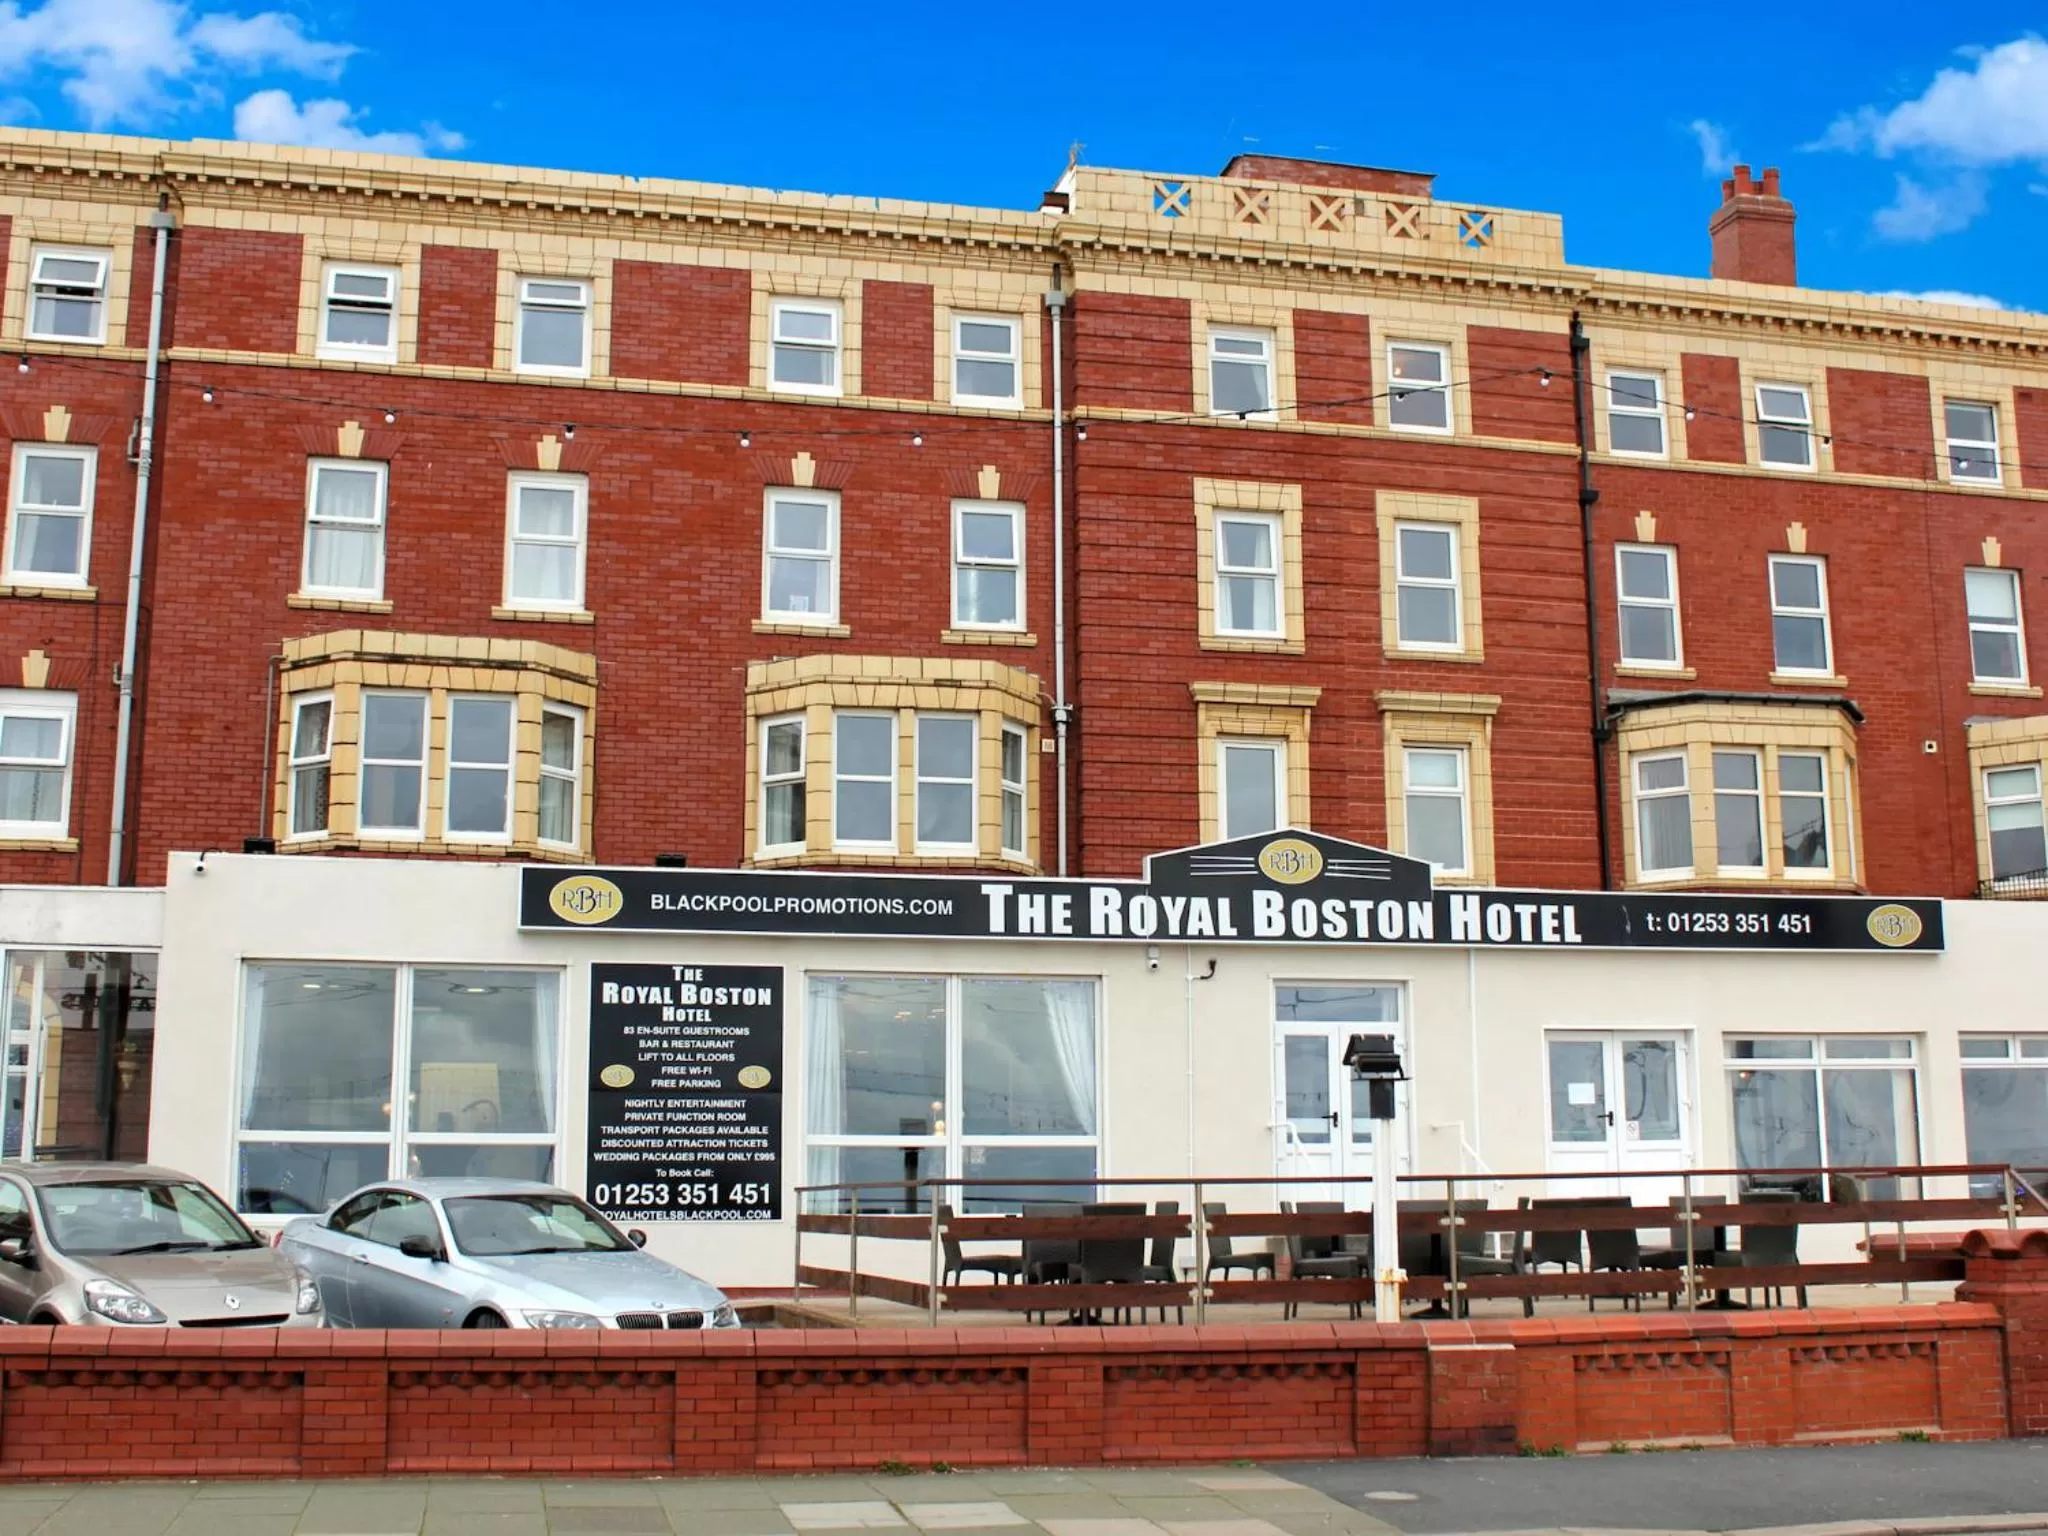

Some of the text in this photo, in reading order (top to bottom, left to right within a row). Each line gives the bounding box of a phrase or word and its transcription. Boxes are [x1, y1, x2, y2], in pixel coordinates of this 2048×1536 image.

[561, 884, 614, 915] RBH
[650, 893, 953, 917] BLACKPOOLPROMOTIONS.COM
[981, 884, 1583, 944] THE ROYAL BOSTON HOTEL
[1646, 913, 1811, 934] t: 01253 351 451
[672, 966, 704, 981] THE
[602, 982, 772, 1006] ROYAL BOSTON
[662, 1006, 712, 1022] HOTEL
[637, 1027, 681, 1035] EN-SUITE
[682, 1027, 750, 1035] GUESTROOMS
[639, 1040, 735, 1048] BAR & RESTAURANT
[638, 1053, 736, 1062] LIFT TO ALL FLOORS
[661, 1066, 713, 1075] FREE WI-FI
[651, 1080, 722, 1088] FREE PARKING
[624, 1099, 748, 1108] NIGHTLY ENTERTAINMENT
[624, 1112, 746, 1121] PRIVATE FUNCTION ROOM
[601, 1126, 769, 1134] TRANSPORT PACKAGES AVAILABLE
[601, 1139, 769, 1148] DISCOUNTED ATTRACTION TICKETS
[593, 1152, 640, 1161] WEDDING
[642, 1152, 695, 1161] PACKAGES
[696, 1152, 725, 1161] FROM
[727, 1152, 752, 1161] ONLY
[655, 1168, 714, 1177] To Book Call:
[594, 1183, 771, 1205] 01253 351 451
[601, 1209, 772, 1221] OYALHOTELSBLACKPOOL.COM
